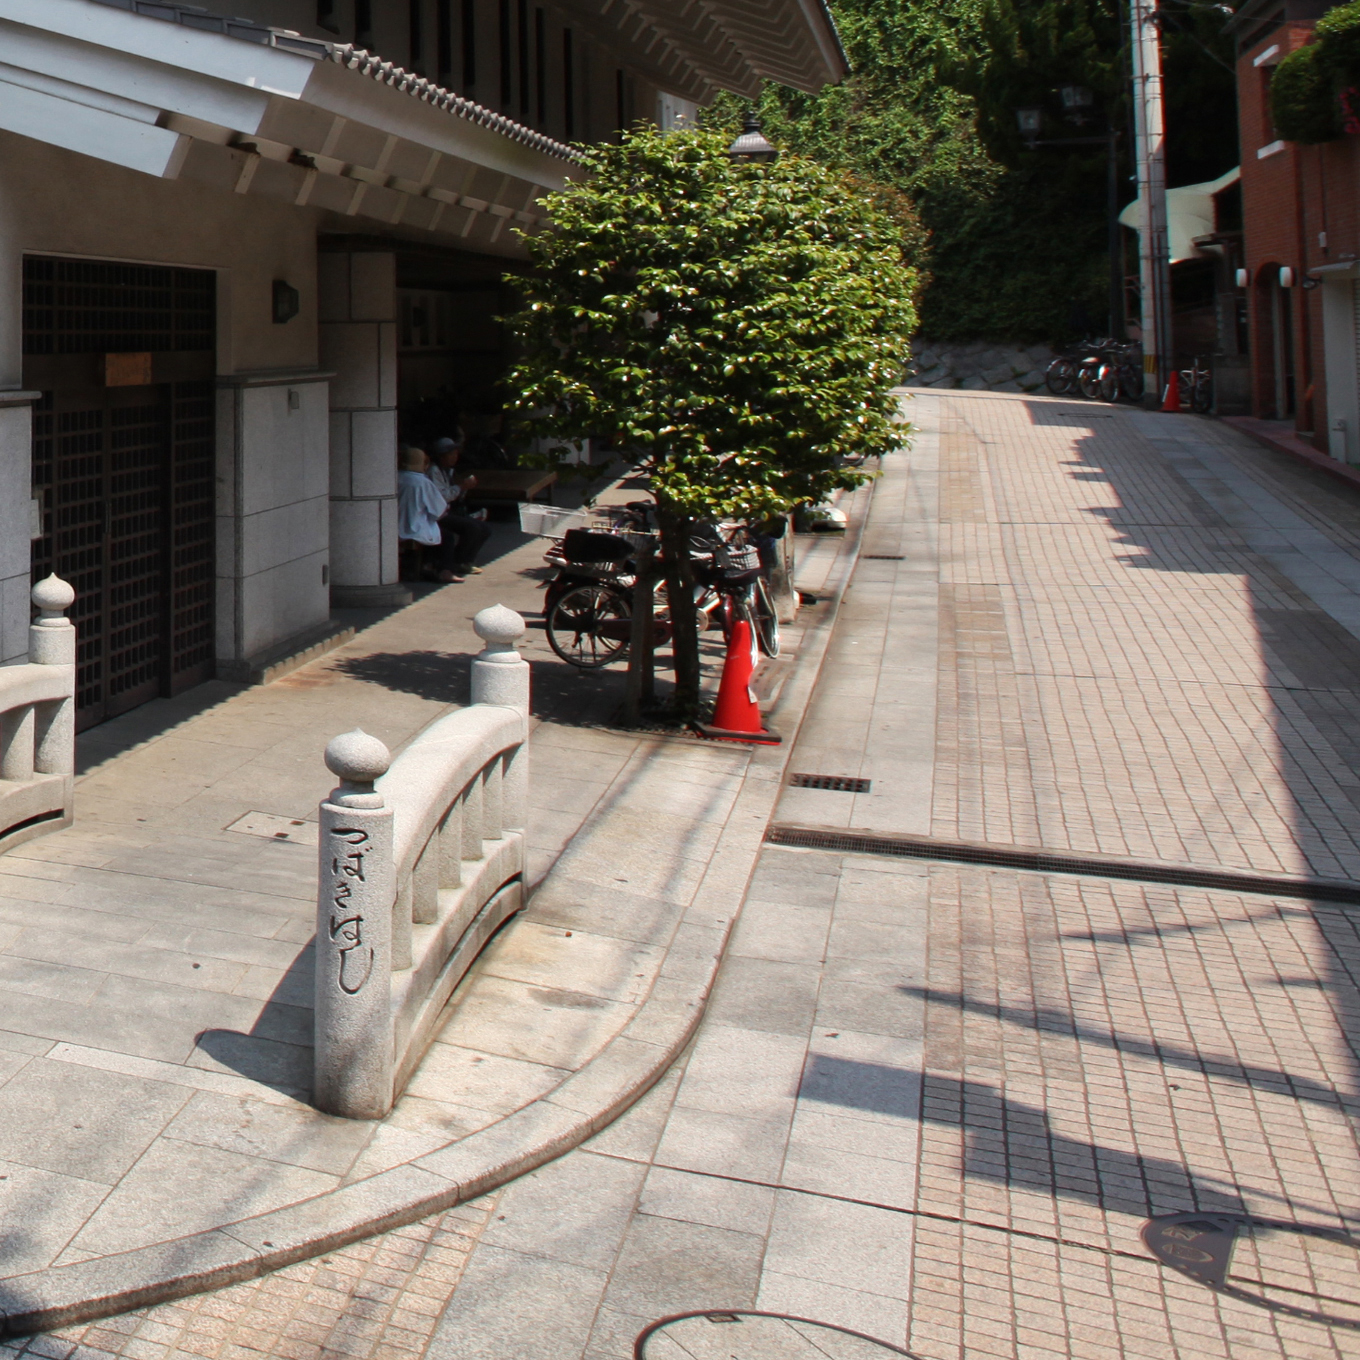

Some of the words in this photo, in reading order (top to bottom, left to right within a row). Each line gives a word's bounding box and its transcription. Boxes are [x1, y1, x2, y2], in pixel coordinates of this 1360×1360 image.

[330, 827, 374, 995] つばきはし
